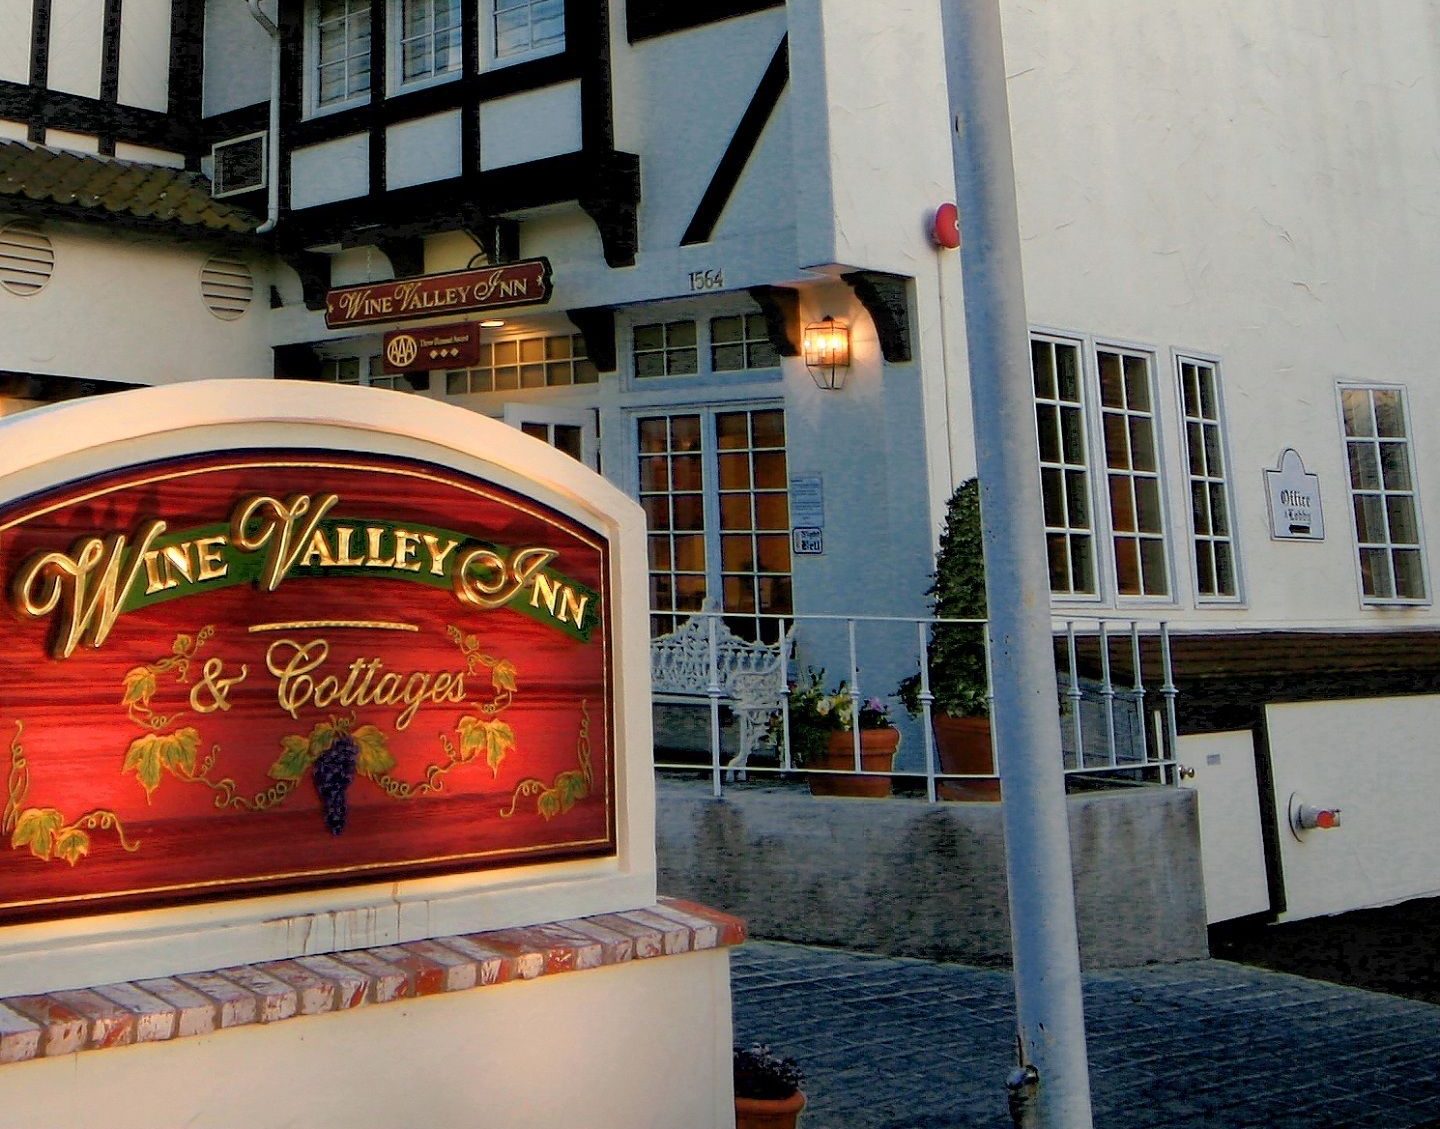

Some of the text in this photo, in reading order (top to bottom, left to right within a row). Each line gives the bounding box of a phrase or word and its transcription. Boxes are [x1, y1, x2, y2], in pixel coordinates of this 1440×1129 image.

[394, 281, 471, 311] VALLEY
[474, 270, 528, 301] INN
[689, 268, 724, 290] 1564
[1280, 489, 1311, 508] Office
[231, 493, 457, 591] VALLEY
[452, 547, 590, 629] INN
[189, 638, 469, 731] & Cottages
